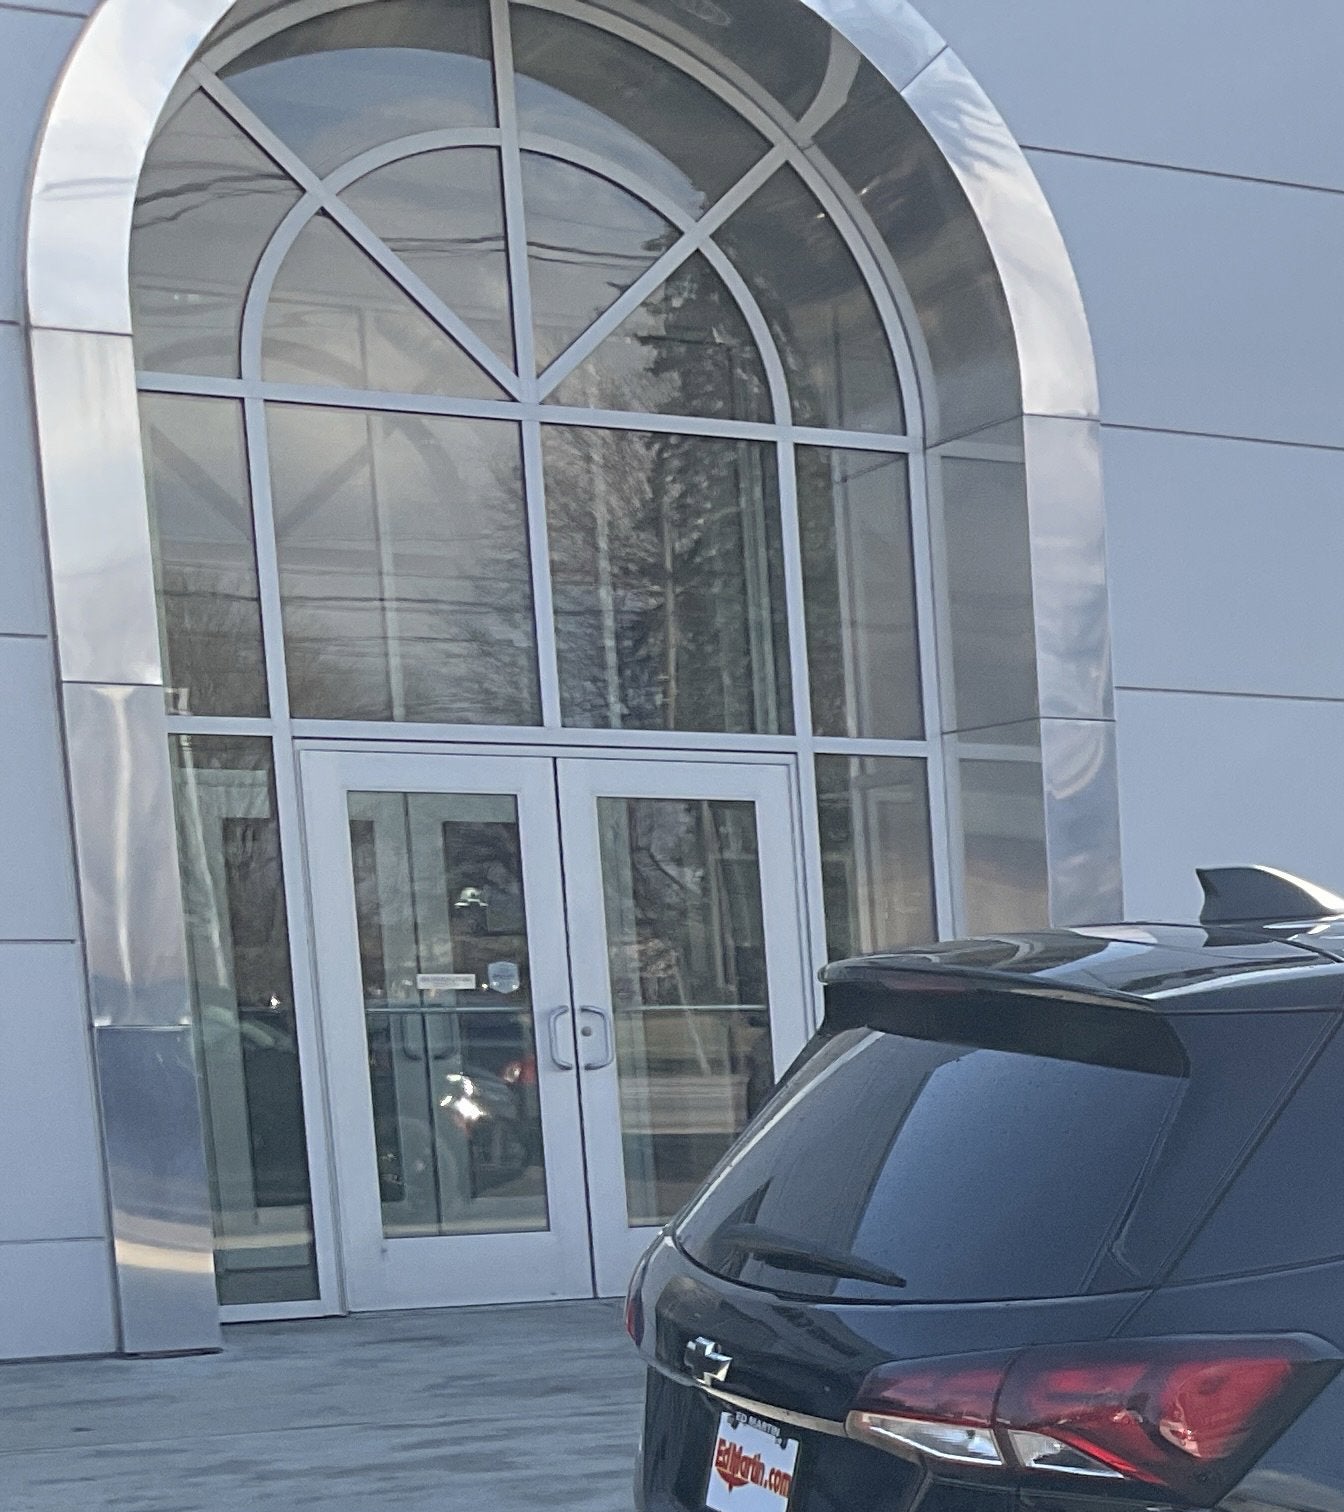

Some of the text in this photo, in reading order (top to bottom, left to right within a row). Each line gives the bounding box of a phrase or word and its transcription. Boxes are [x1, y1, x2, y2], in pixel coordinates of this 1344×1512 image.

[735, 1411, 781, 1437] ED MARTIN
[714, 1437, 793, 1498] EdMartin.com
